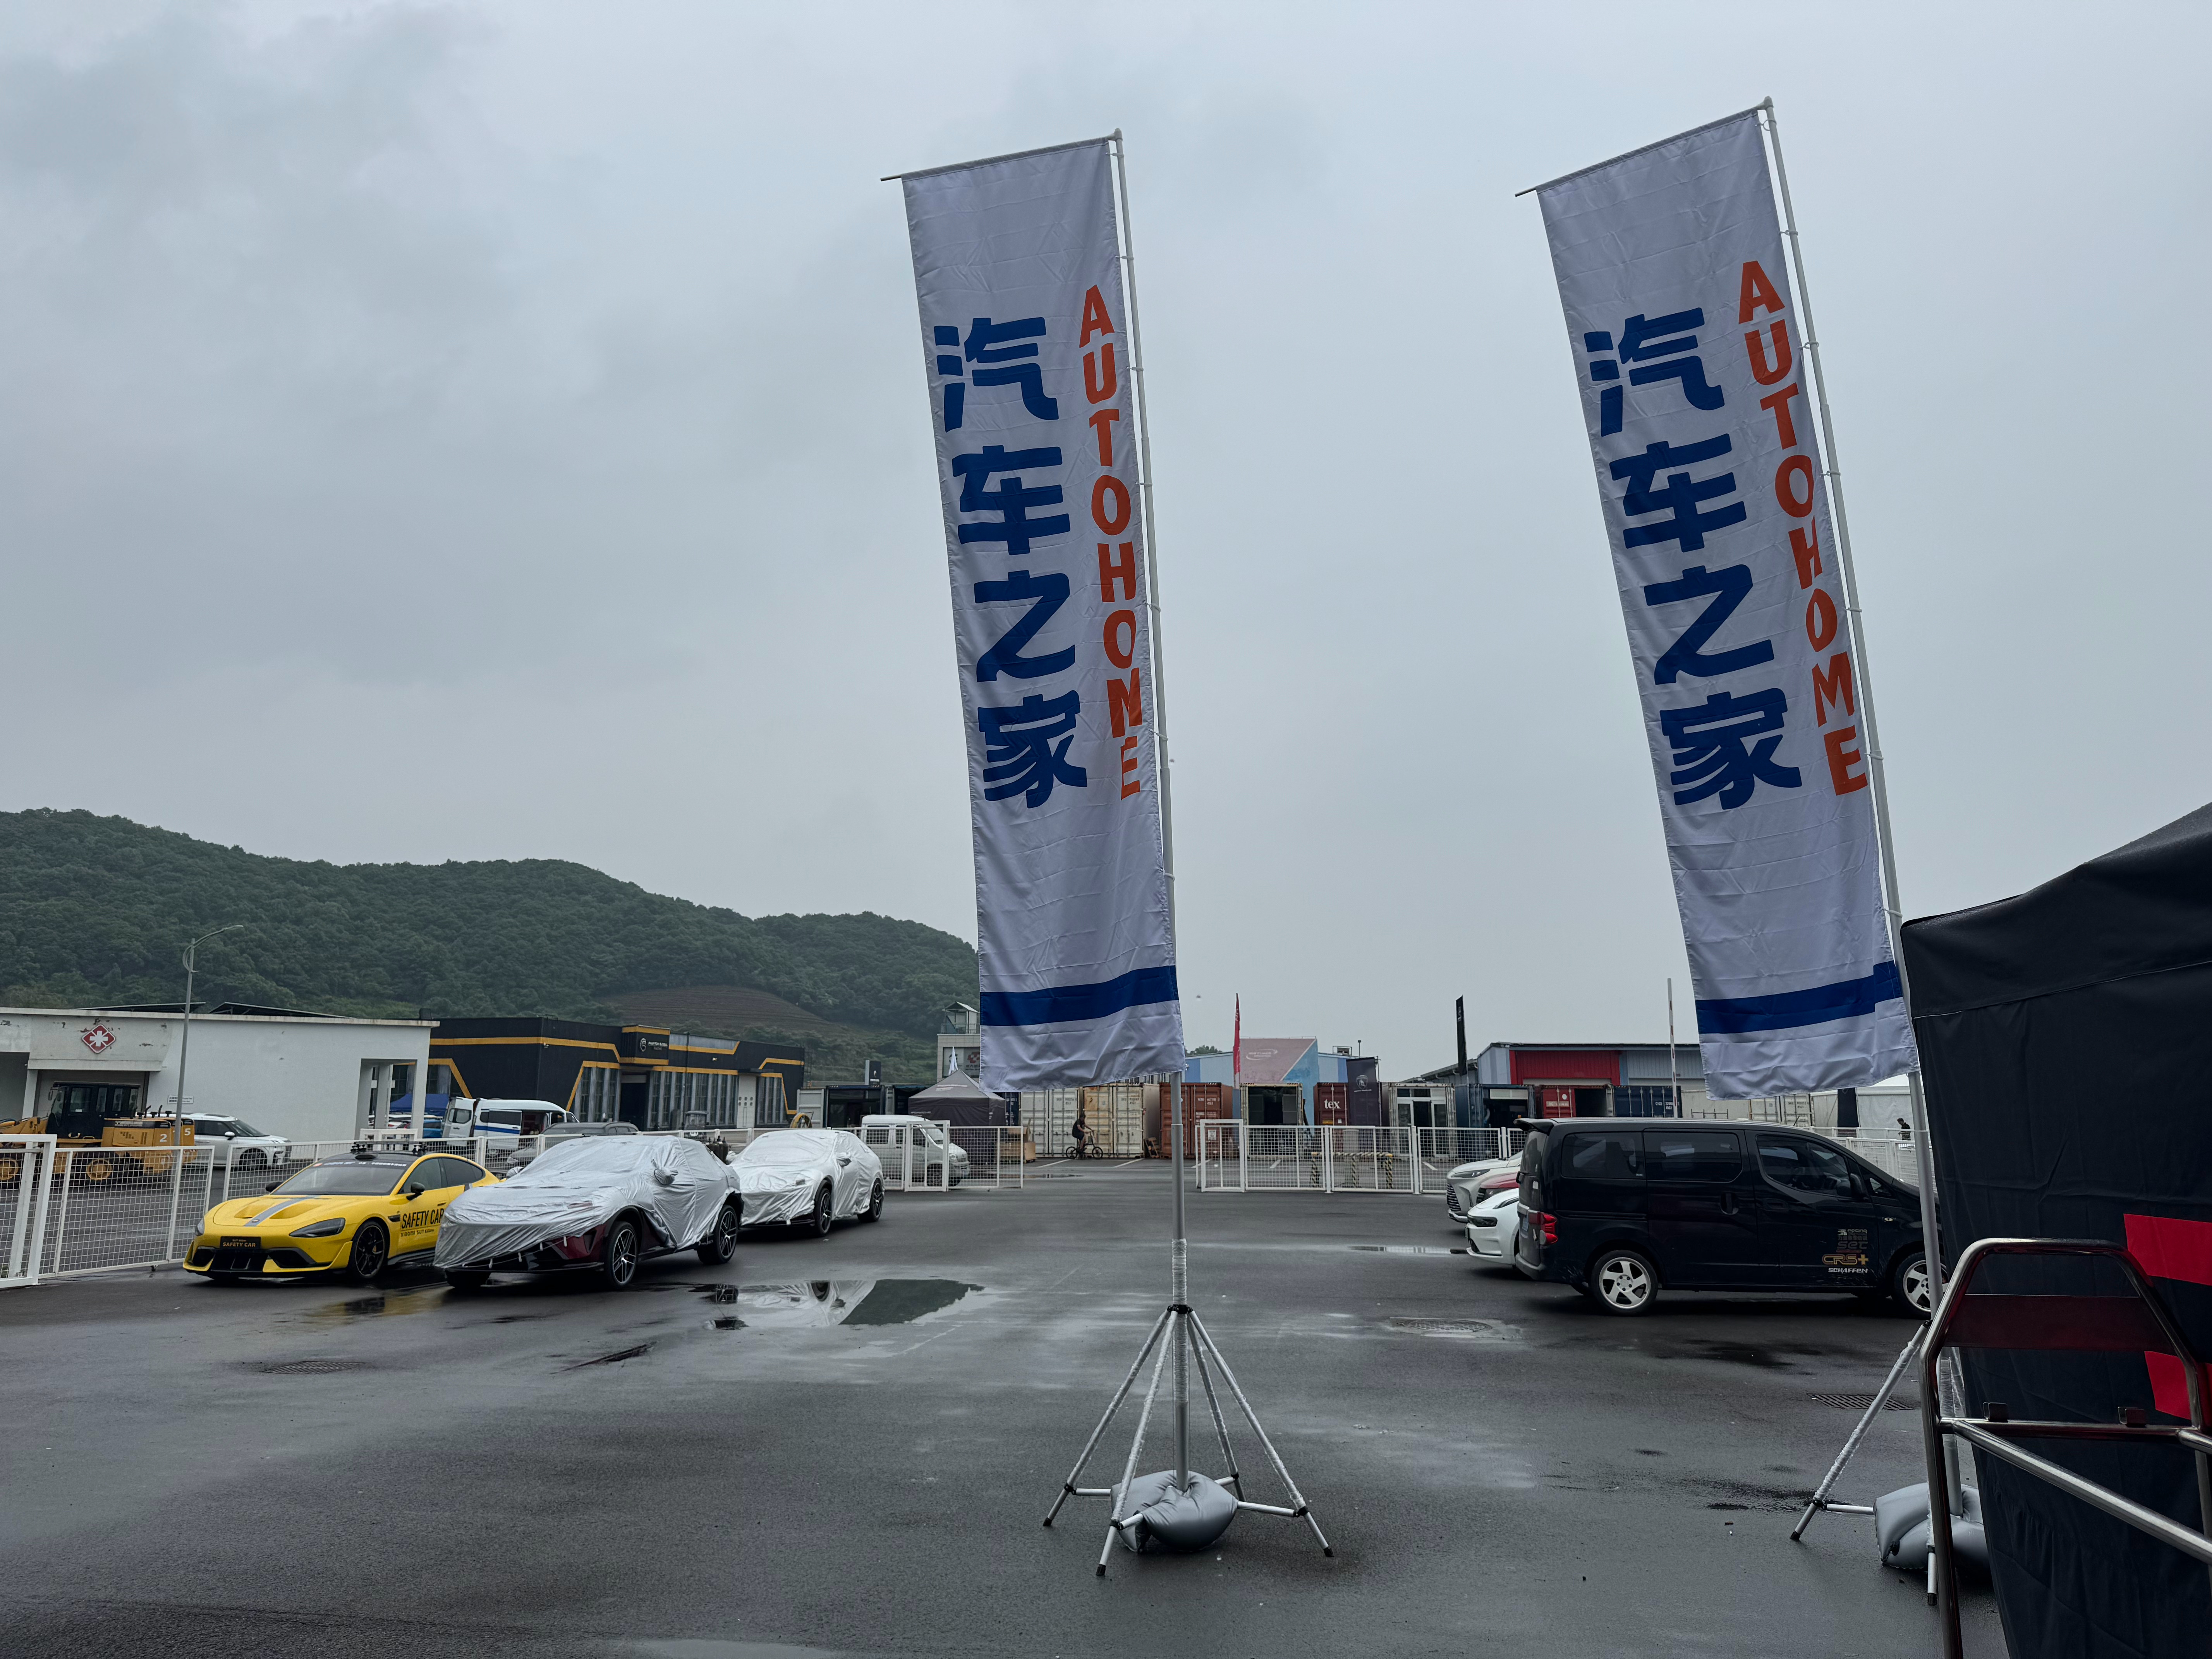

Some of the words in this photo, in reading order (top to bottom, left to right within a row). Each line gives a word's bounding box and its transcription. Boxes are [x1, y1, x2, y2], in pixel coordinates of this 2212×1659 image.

[934, 317, 1088, 809] 汽车之家
[1079, 285, 1142, 800] AUTOHOME
[1584, 307, 1802, 810] 汽车之家
[1739, 261, 1868, 796] AUTOHOME
[160, 1133, 167, 1142] 2
[184, 1128, 191, 1136] 5
[401, 1210, 429, 1229] SAFETY
[430, 1208, 444, 1224] CAR
[1324, 1099, 1341, 1109] tex
